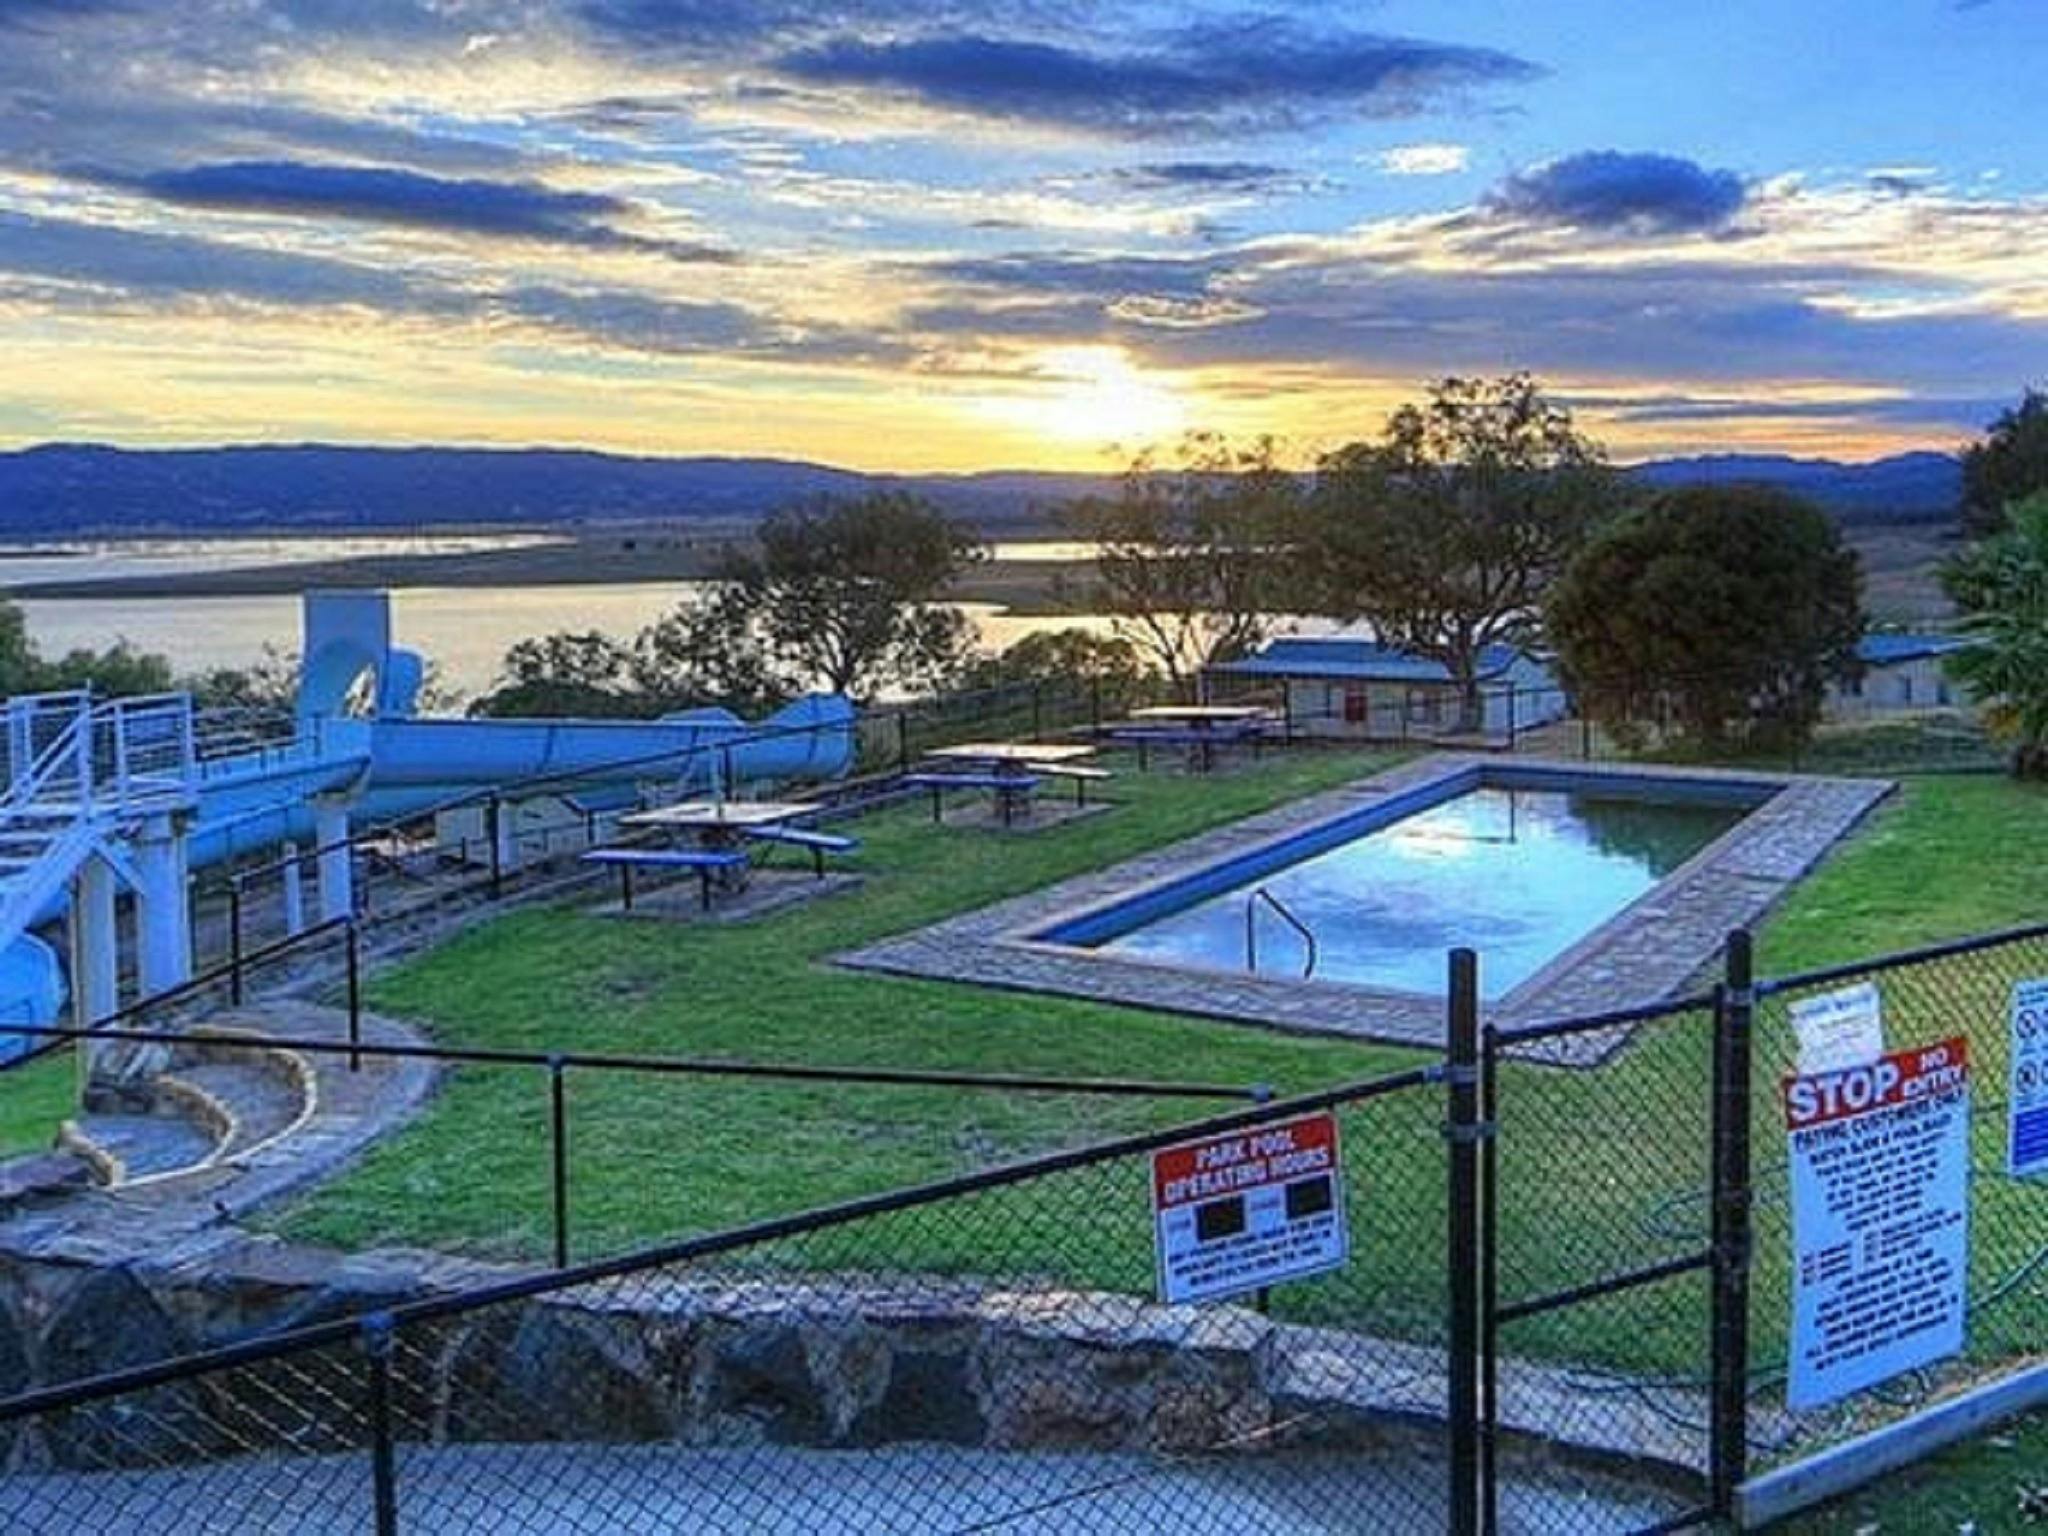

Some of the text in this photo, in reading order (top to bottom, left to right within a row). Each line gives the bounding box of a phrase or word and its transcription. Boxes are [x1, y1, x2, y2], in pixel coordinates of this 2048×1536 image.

[1920, 1046, 1948, 1071] NO
[1788, 1062, 1899, 1121] STOP
[1250, 1129, 1296, 1157] POOL
[1165, 1160, 1268, 1203] OPERATING
